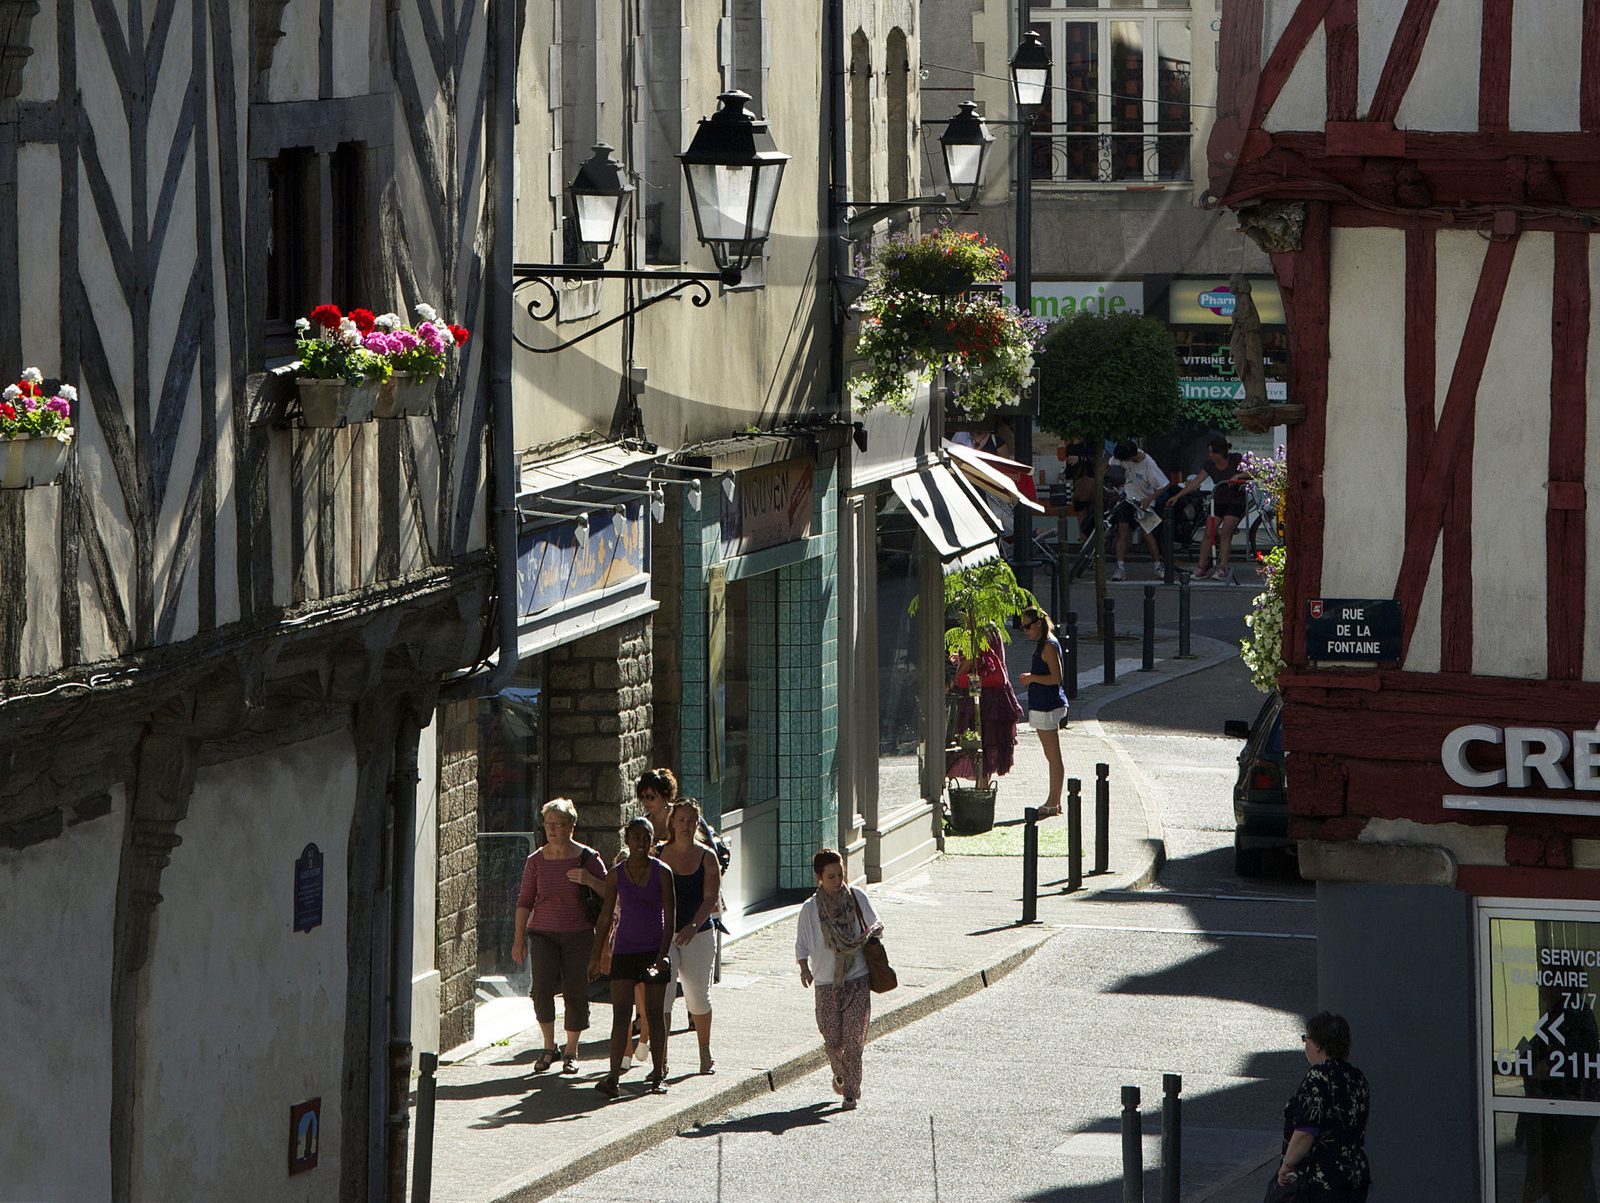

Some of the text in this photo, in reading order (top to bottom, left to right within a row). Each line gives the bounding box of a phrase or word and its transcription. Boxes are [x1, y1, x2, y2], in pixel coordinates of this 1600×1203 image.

[1003, 286, 1126, 319] macie
[1183, 356, 1225, 365] VITRINE
[1342, 607, 1365, 620] RUE
[1336, 624, 1371, 637] DE LA
[1327, 640, 1380, 654] FONTAINE
[1511, 968, 1588, 988] BANCAIRE
[1561, 992, 1597, 1011] 7J/7
[1497, 1048, 1600, 1079] 6H 21H
